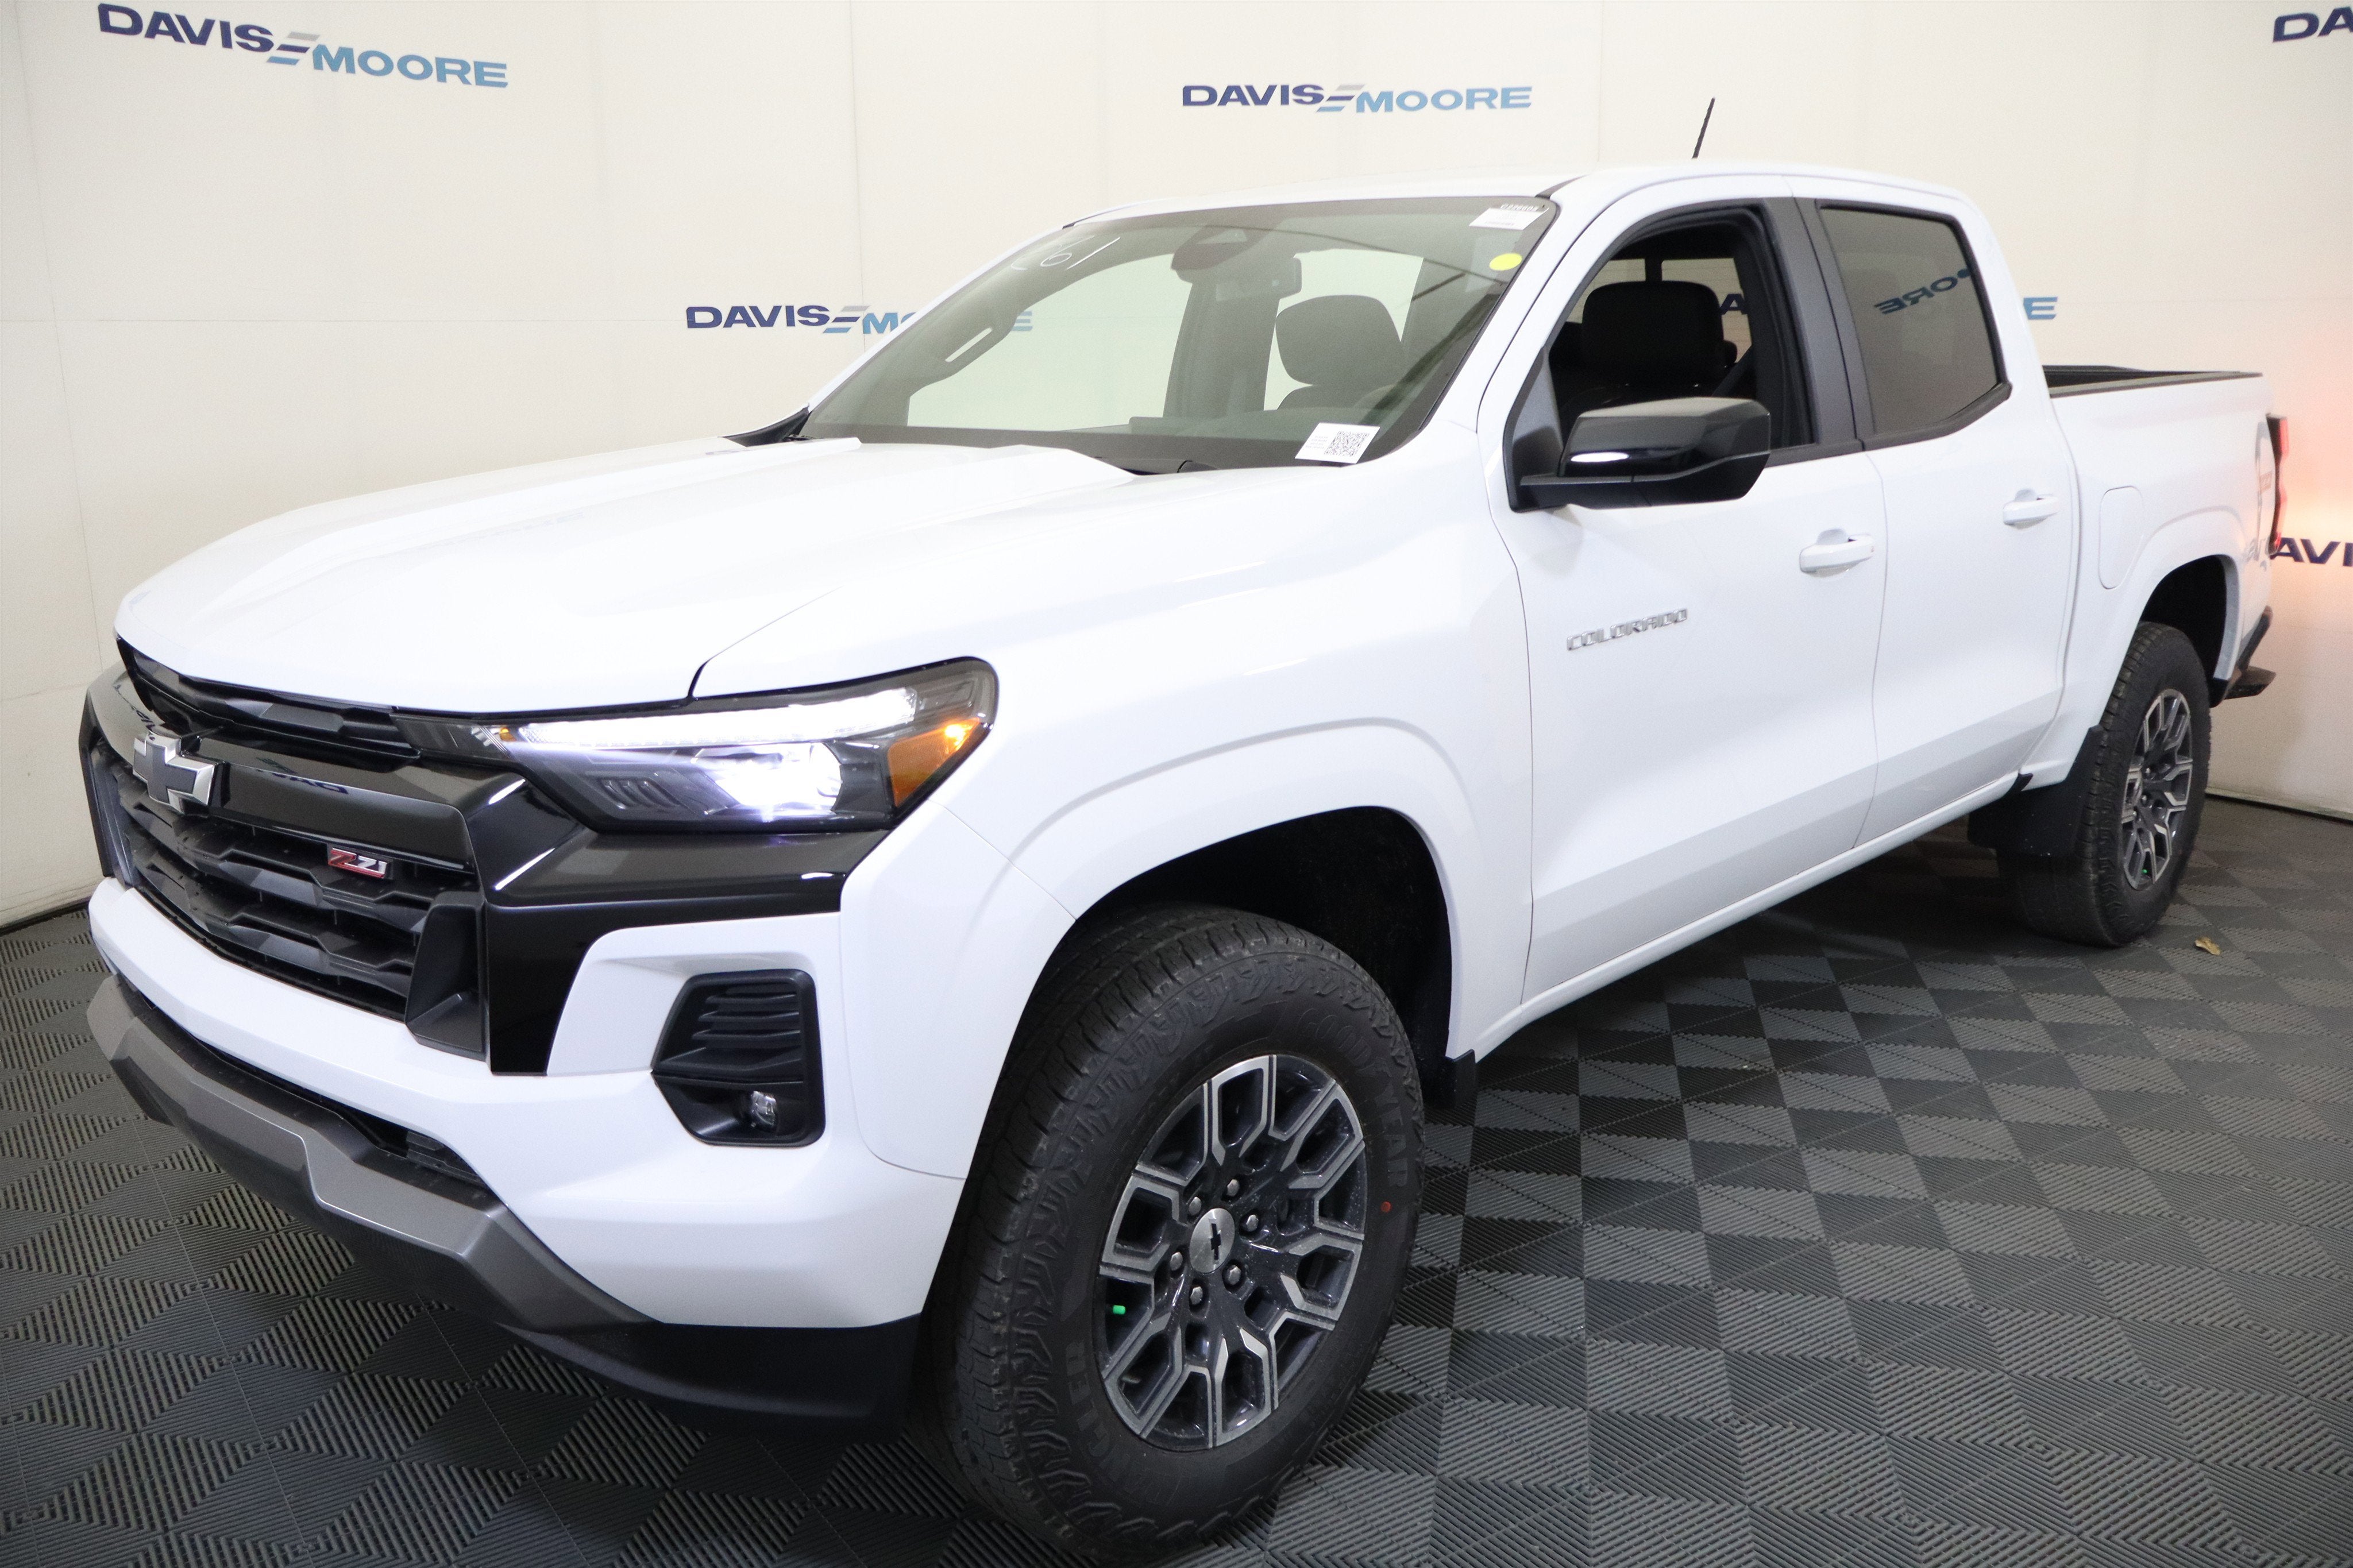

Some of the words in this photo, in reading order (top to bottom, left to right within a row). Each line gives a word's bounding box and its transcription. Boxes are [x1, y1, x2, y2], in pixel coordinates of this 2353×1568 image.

[98, 3, 274, 52] DAVIS
[312, 44, 509, 88] MOORE
[1182, 84, 1325, 106] DAVIS
[1356, 86, 1532, 113] MOORE
[686, 305, 831, 329] DAVIS
[1567, 608, 1688, 651] COLORADO
[328, 848, 387, 879] Z71
